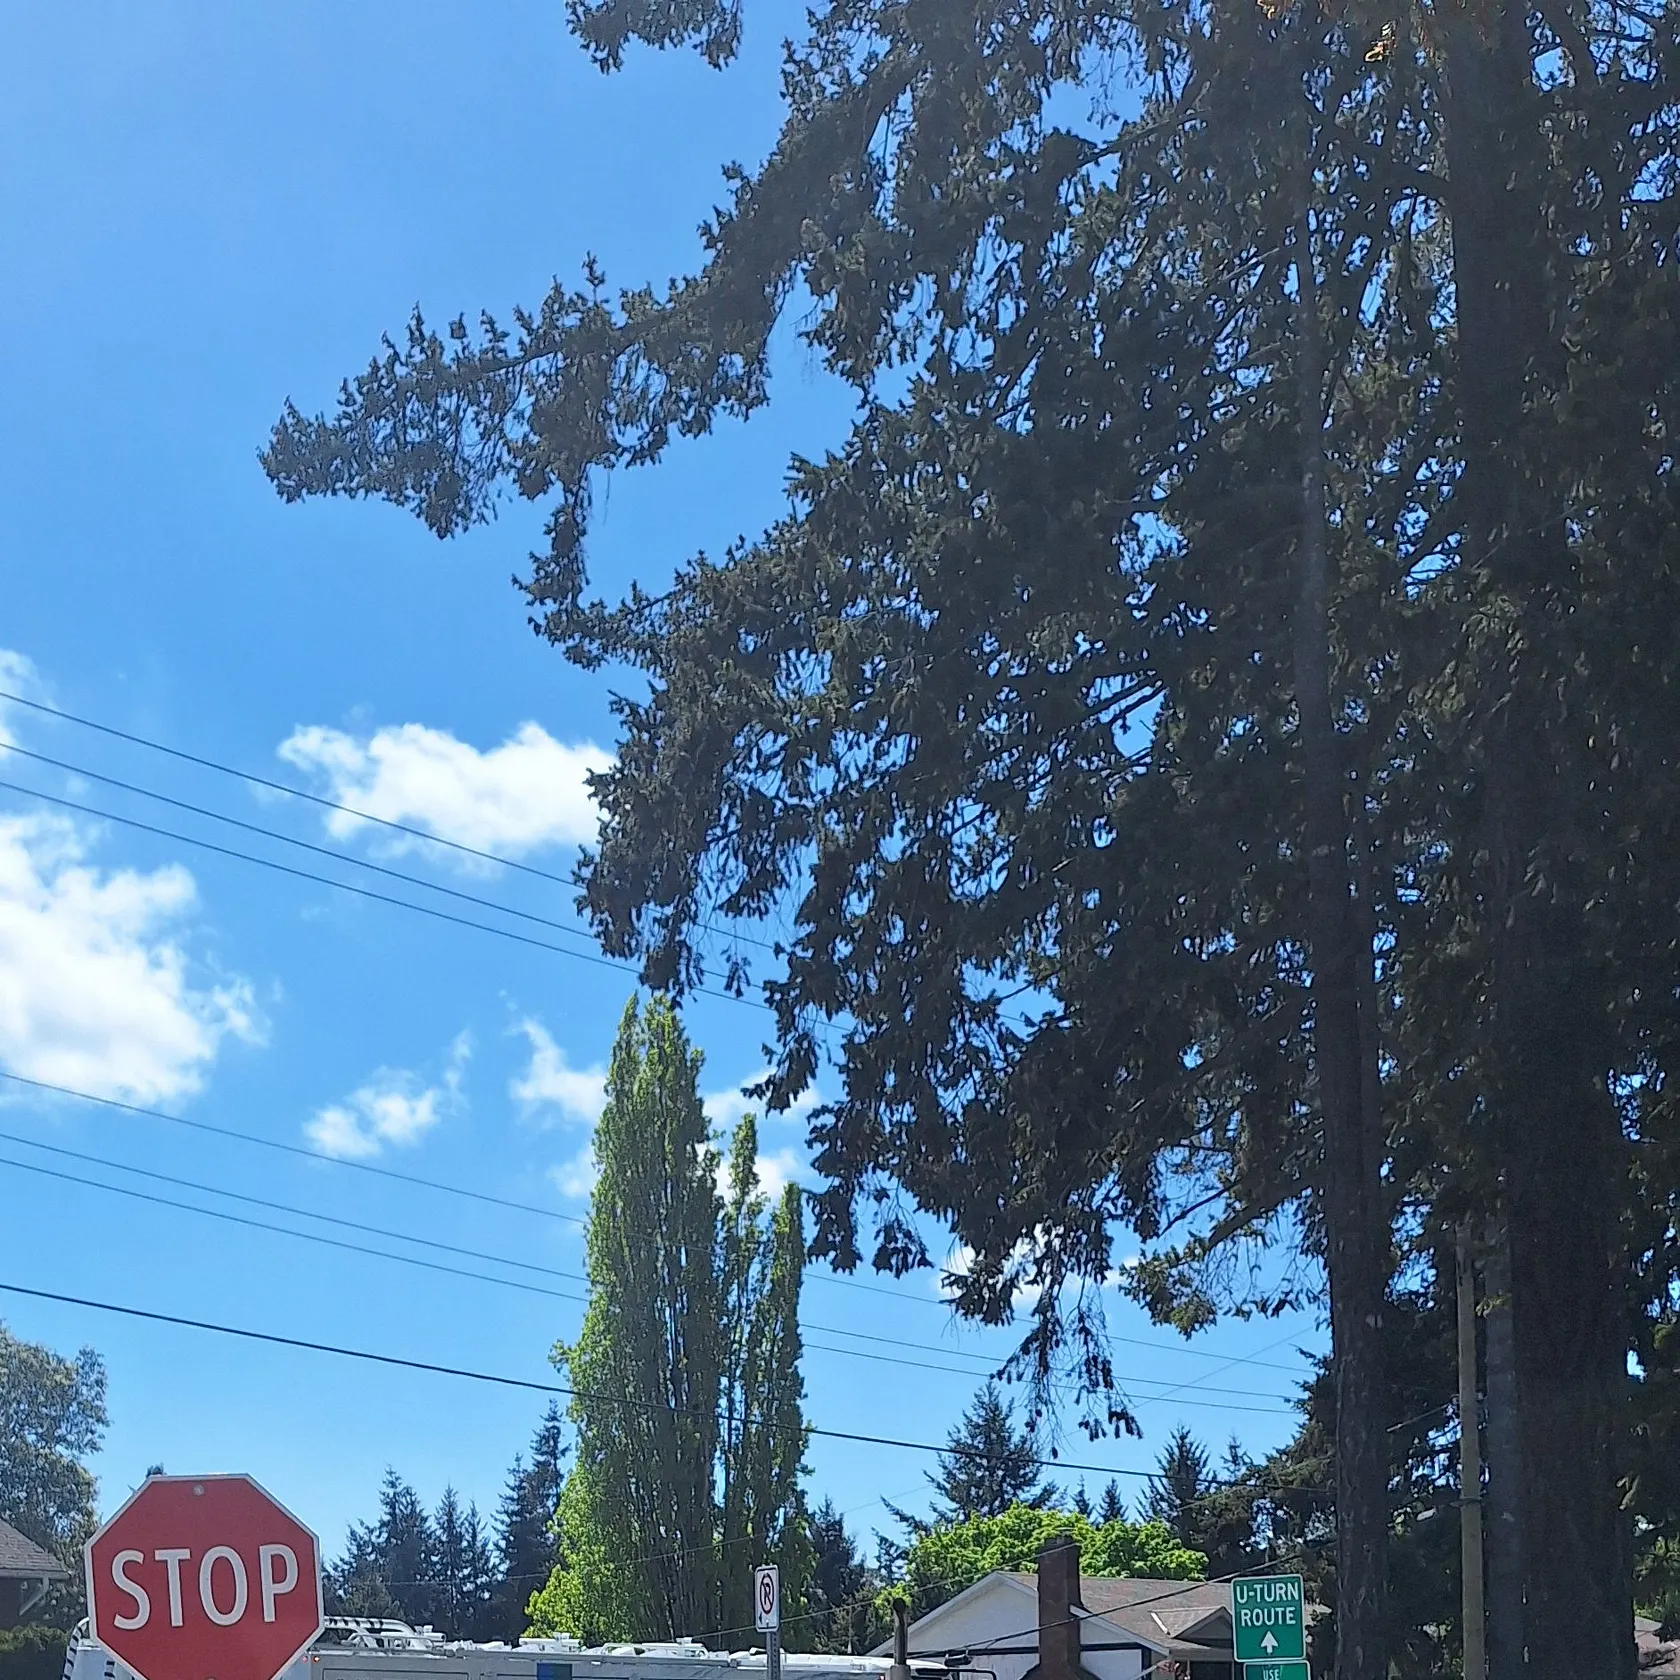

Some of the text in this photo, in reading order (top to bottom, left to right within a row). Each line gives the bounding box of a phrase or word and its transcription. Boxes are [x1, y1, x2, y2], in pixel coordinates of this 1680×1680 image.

[111, 1544, 299, 1630] STOP
[1236, 1582, 1299, 1604] U-TURN
[1240, 1606, 1296, 1627] ROUTE
[1263, 1668, 1280, 1680] USE
